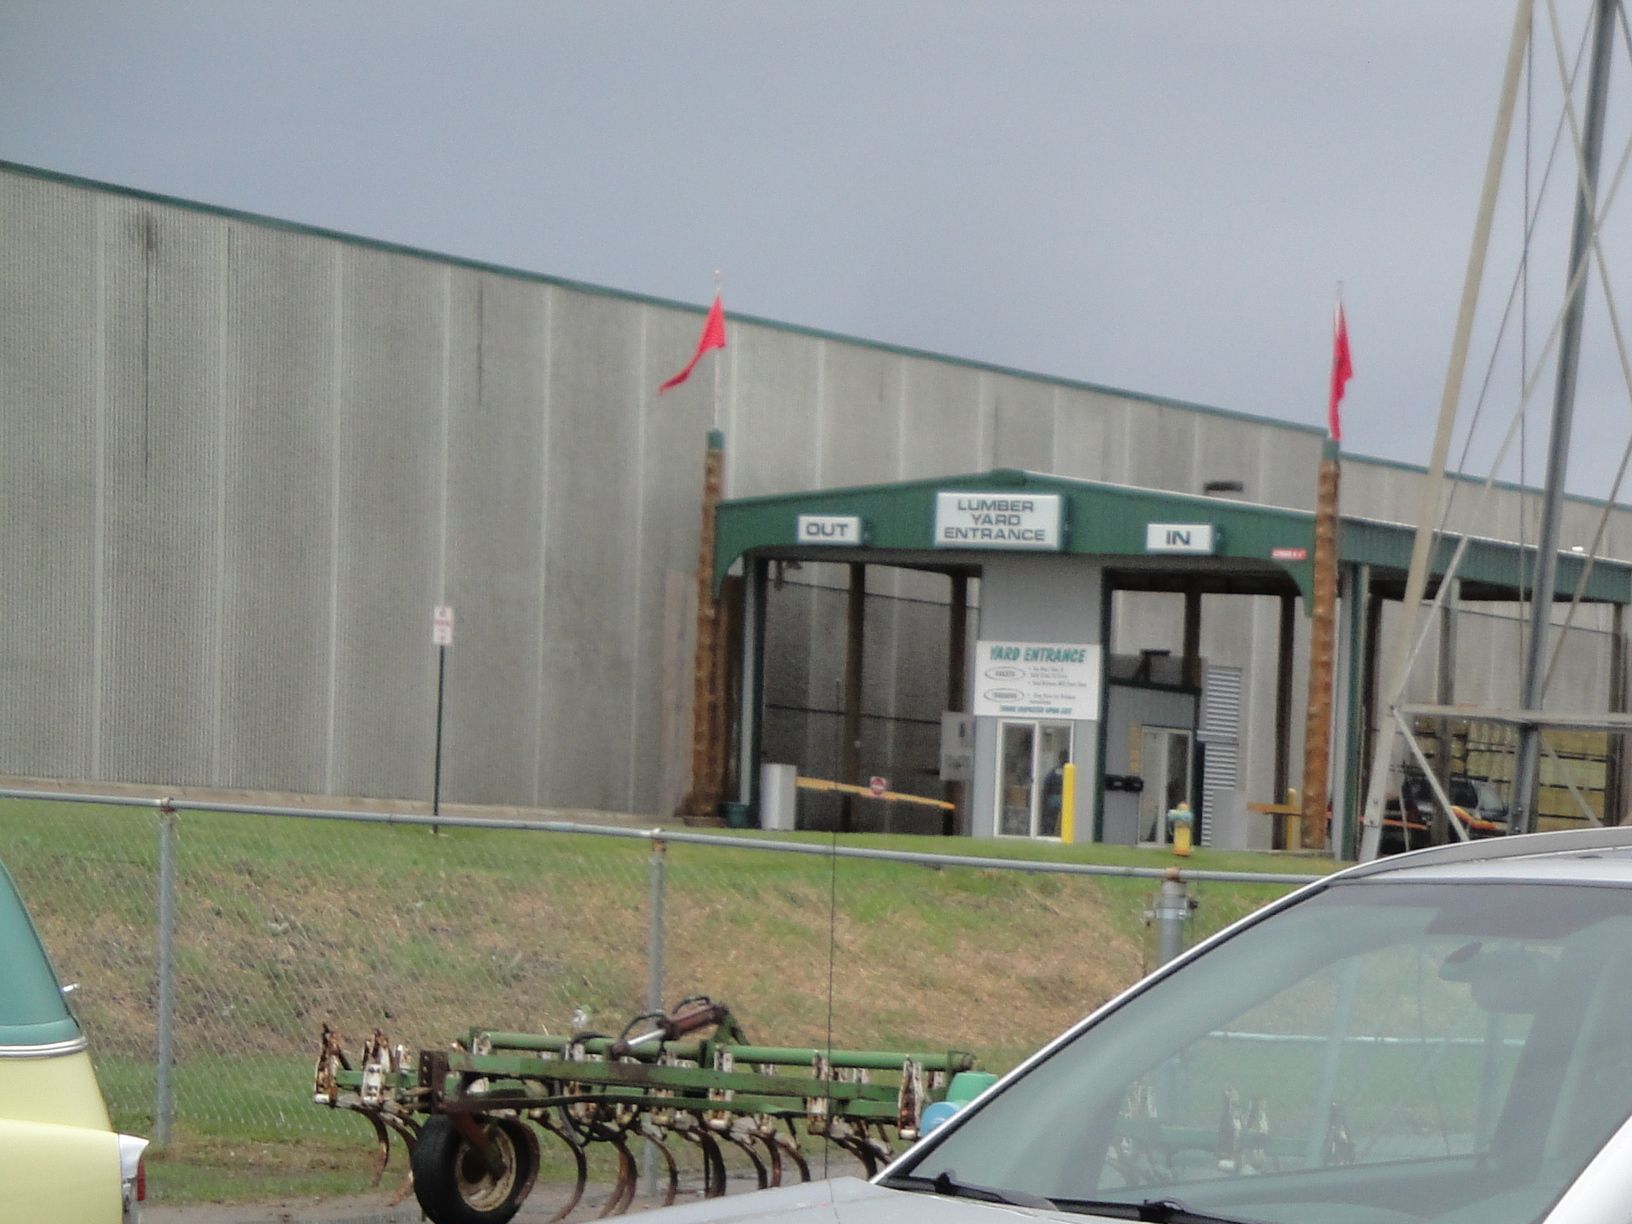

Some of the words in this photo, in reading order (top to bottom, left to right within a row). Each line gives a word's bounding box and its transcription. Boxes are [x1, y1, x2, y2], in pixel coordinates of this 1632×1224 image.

[957, 499, 1034, 512] LUMBER
[971, 514, 1021, 526] YARD
[806, 522, 848, 537] OUT
[944, 527, 1046, 541] ENTRANCE
[1166, 530, 1191, 546] IN
[991, 646, 1021, 661] YARD
[1024, 647, 1087, 664] ENTRANCE
